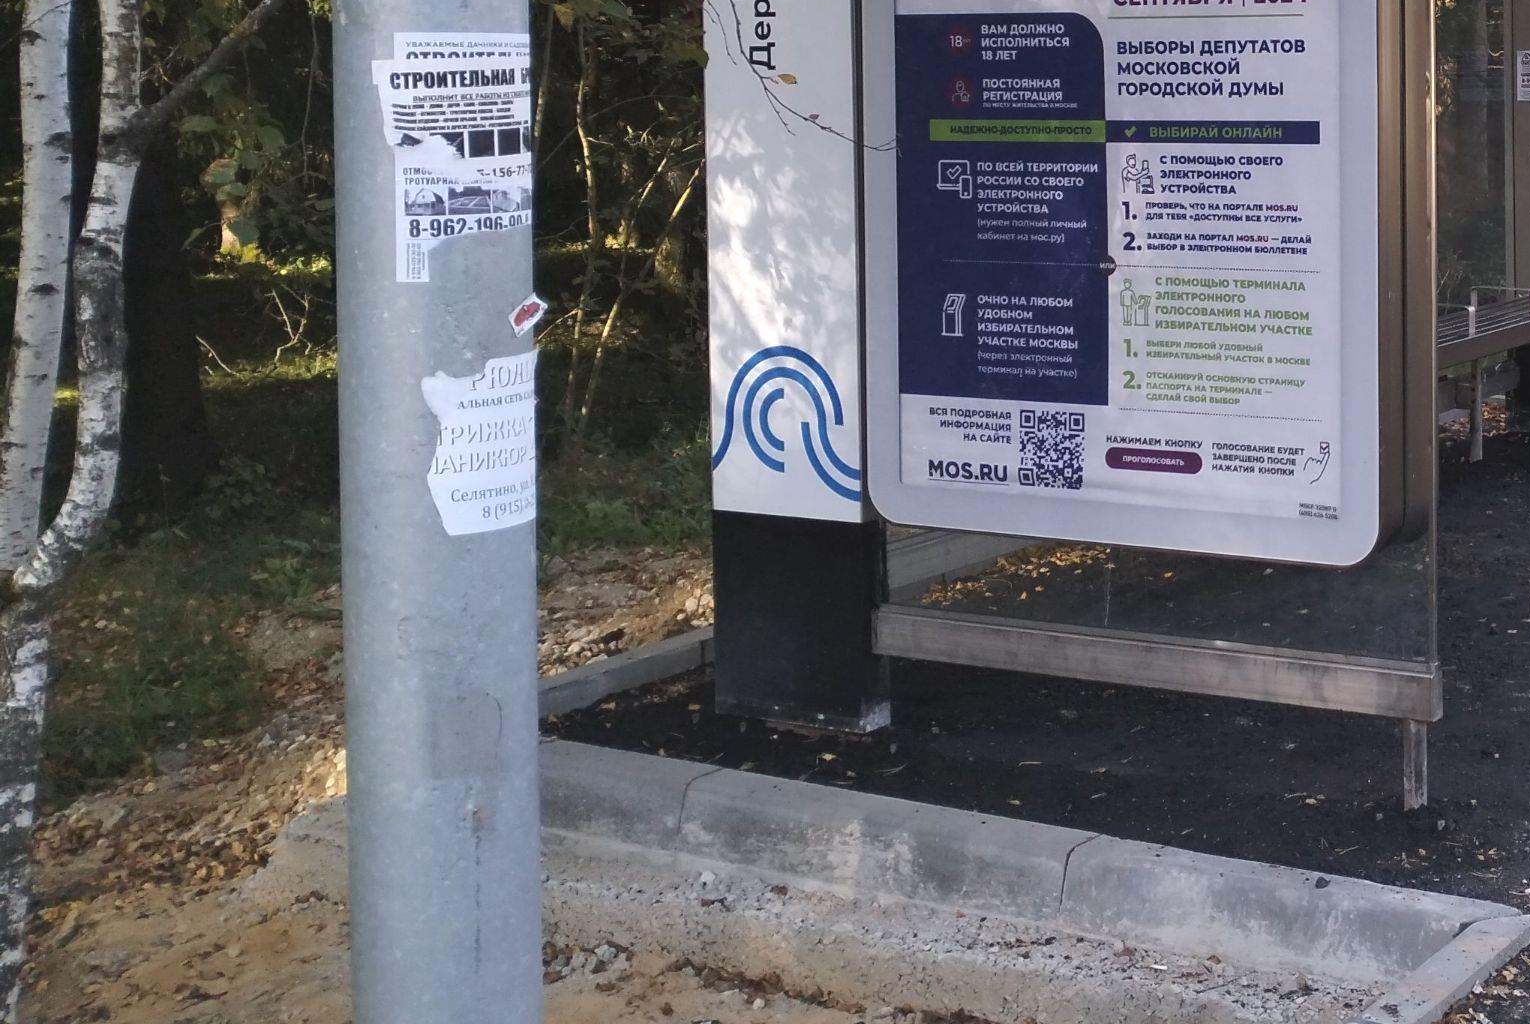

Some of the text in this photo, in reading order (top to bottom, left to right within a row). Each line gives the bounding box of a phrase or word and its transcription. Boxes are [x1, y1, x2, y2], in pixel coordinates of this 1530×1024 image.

[981, 23, 1065, 36] ВАМ ДОЛЖНО
[981, 37, 1070, 48] ИСПОЛНИТЬСЯ
[1116, 39, 1306, 56] ВЫБОРЫ ДЕПУТАТОВ
[981, 50, 1018, 61] 18 ЛЕТ
[1117, 58, 1240, 76] МОСКОВСКОЙ
[389, 67, 516, 90] СТРОИТЕЛЬНАЯ
[982, 78, 1061, 89] ПОСТОЯННАЯ
[1117, 79, 1284, 98] ГОРОДСКОЙ ДУМЫ
[982, 91, 1063, 102] РЕГИСТРАЦИЯ
[1149, 125, 1282, 139] ВЫБИРАЙ ОНЛАЙН
[977, 161, 1099, 173] ПО ВСЕЙ ТЕРРИТОРИИ
[1160, 155, 1284, 167] С ПОМОЩЬЮ СВОЕГО
[1160, 169, 1252, 180] ЭЛЕКТРОННОГО
[977, 176, 1084, 187] РОССИИ СО СВОЕГО
[977, 190, 1064, 200] ЭЛЕКТРОННОГО
[1160, 183, 1237, 195] УСТРОЙСТВА
[977, 203, 1049, 214] УСТРОЙСТВА
[1121, 201, 1138, 220] 1.
[1145, 202, 1299, 212] ПРОВЕРЬ, ЧТО НА ПОРТАЛЕ MOS.RU
[1011, 219, 1049, 228] полный
[1051, 219, 1087, 228] личный
[1145, 213, 1163, 222] ДЛЯ
[1165, 213, 1187, 221] ТЕБЯ
[1245, 214, 1261, 223] ВСЕ
[977, 232, 1015, 241] кабинет
[1122, 231, 1143, 252] 2.
[1146, 233, 1182, 242] ЗАХОДИ
[1198, 234, 1234, 242] ПОРТАЛ
[1236, 234, 1269, 243] MOS.RU
[1280, 234, 1312, 244] ДЕЛАЙ
[1147, 243, 1178, 251] ВЫБОР
[1187, 244, 1252, 254] ЭЛЕКТРОННОМ
[1254, 246, 1308, 255] БЮЛЛЕТЕНЕ
[1155, 277, 1306, 291] С ПОМОЩЬЮ ТЕРМИНАЛА
[977, 294, 1073, 307] ОЧНО НА ЛЮБОМ
[1155, 291, 1246, 303] ЭЛЕКТРОННОГО
[977, 309, 1033, 320] УДОБНОМ
[1155, 306, 1310, 321] ГОЛОСОВАНИЯ НА ЛЮБОМ
[977, 322, 1074, 335] ИЗБИРАТЕЛЬНОМ
[1155, 320, 1313, 336] ИЗБИРАТЕЛЬНОМ УЧАСТКЕ
[977, 336, 1078, 350] УЧАСТКЕ МОСКВЫ
[1123, 338, 1138, 358] 1.
[1146, 340, 1264, 352] ВЫБЕРИ ЛЮБОЙ УДОБНЫЙ
[1010, 353, 1073, 364] электронный
[1146, 351, 1222, 362] ИЗБИРАТЕЛЬНЫЙ
[1223, 355, 1265, 364] УЧАСТОК
[1275, 358, 1311, 366] МОСКВЕ
[977, 365, 1023, 377] терминал
[1025, 368, 1037, 376] на
[1122, 370, 1142, 390] 2.
[1146, 371, 1306, 388] ОТСКАНИРУЙ ОСНОВНУЮ СТРАНИЦУ
[1146, 382, 1263, 396] ПАСПОРТА НА ТЕРМИНАЛЕ
[1146, 393, 1241, 405] СДЕЛАЙ СВОЙ ВЫБОР
[929, 407, 1012, 419] ВСЯ ПОДРОБНАЯ
[939, 419, 1012, 432] ИНФОРМАЦИЯ
[963, 433, 1012, 444] НА САЙТЕ
[1106, 435, 1203, 449] НАЖИМАЕМ КНОПКУ
[1211, 442, 1305, 456] ГОЛОСОВАНИЕ БУДЕТ
[1122, 455, 1185, 466] ПРОГОЛОСОВАТЬ
[1212, 453, 1297, 467] ЗАВЕРШЕНО ПОСЛЕ
[928, 459, 1008, 482] MOS.RU
[1211, 463, 1295, 476] НАЖАТИЯ КНОПКИ
[451, 484, 518, 503] Селятино,
[482, 505, 491, 519] 8
[495, 499, 523, 520] (915)
